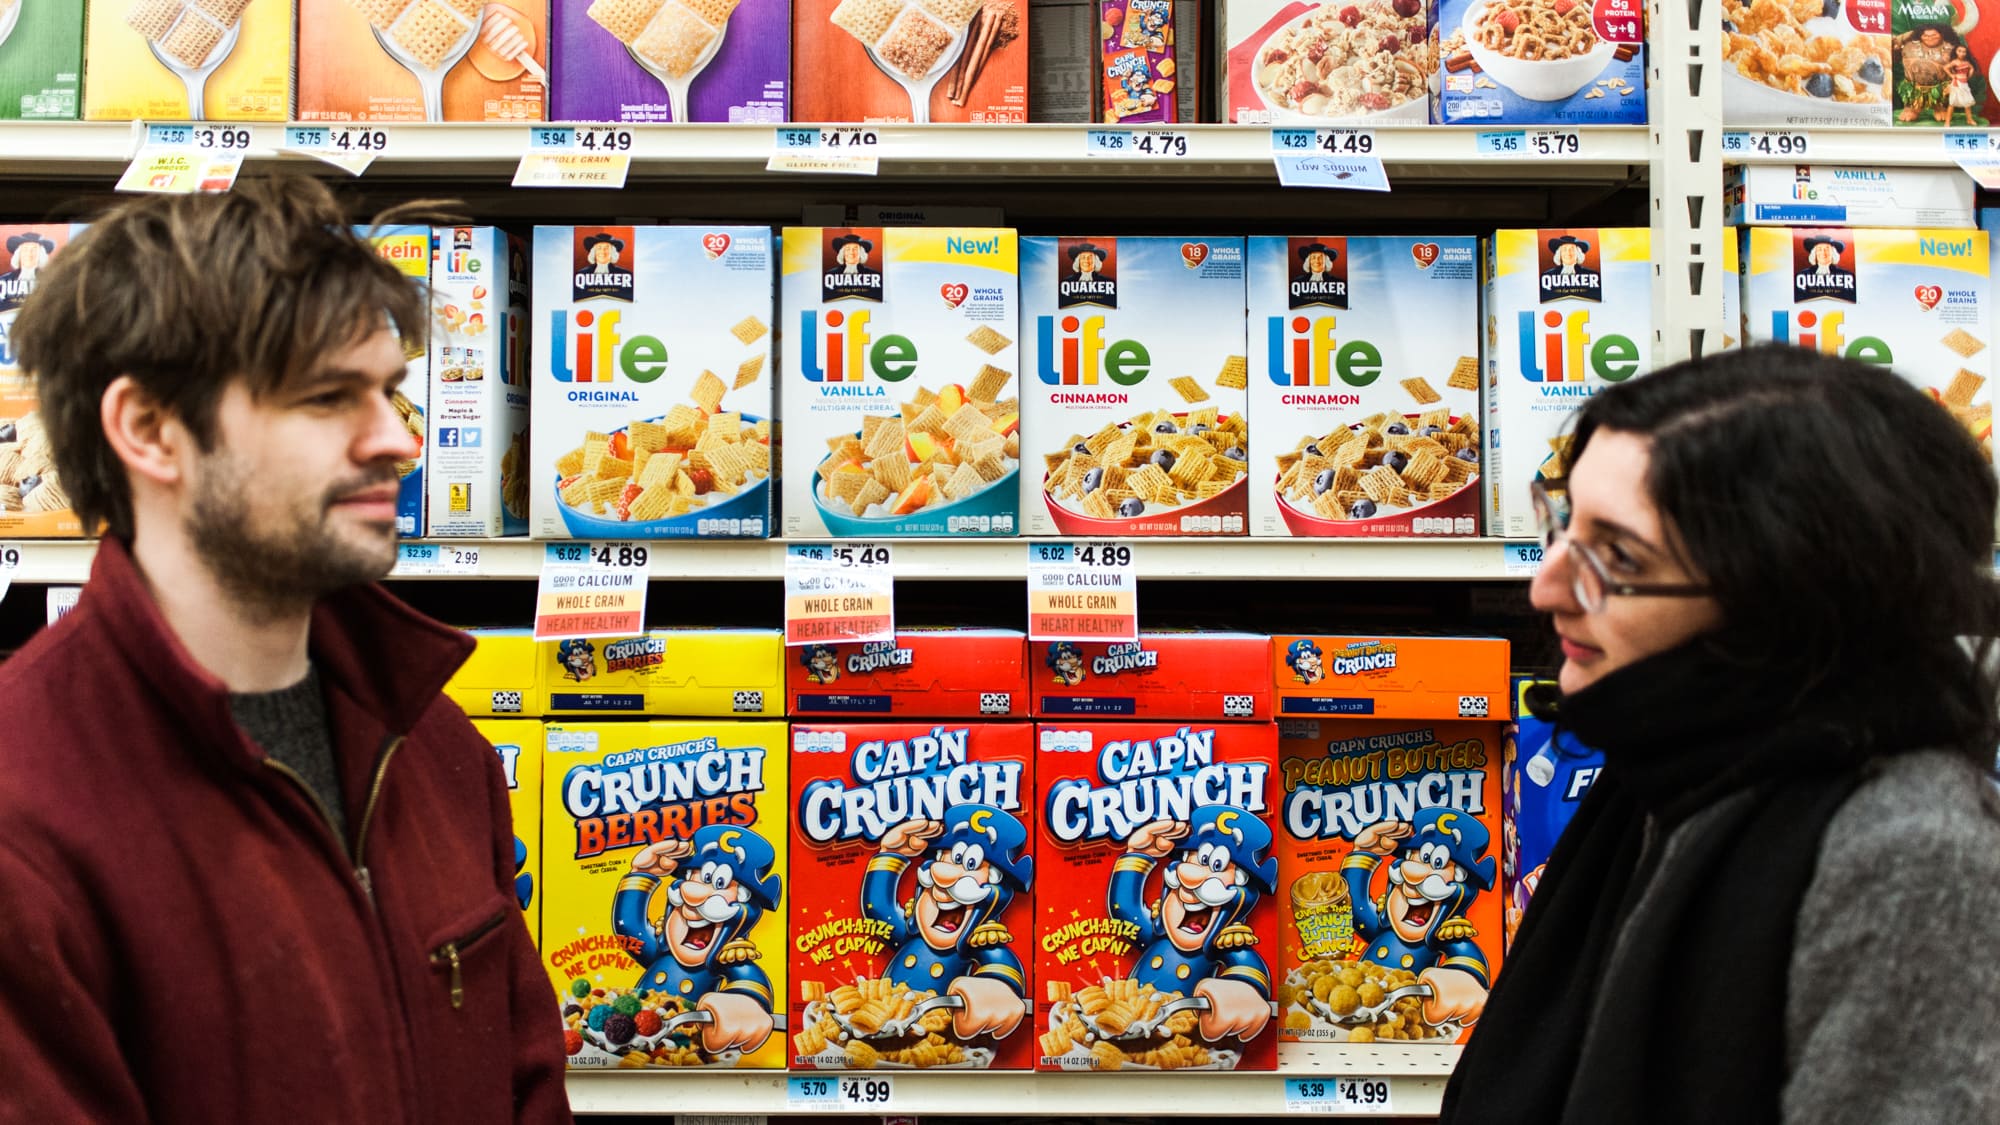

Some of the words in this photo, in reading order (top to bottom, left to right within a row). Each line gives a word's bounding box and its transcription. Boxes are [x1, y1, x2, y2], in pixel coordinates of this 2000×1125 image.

[1898, 5, 1949, 16] MOANA
[1108, 56, 1146, 78] CRUNCH
[195, 130, 249, 148] $3.99
[296, 132, 321, 144] $5.75
[331, 132, 386, 150] $4.49
[540, 133, 565, 145] $5.94
[576, 132, 631, 150] $4.49
[786, 134, 811, 146] $5.94
[1097, 136, 1123, 148] $4.26
[1133, 136, 1186, 156] $4.79
[1281, 135, 1307, 148] $4.23
[1317, 135, 1372, 153] $4.49
[1492, 138, 1517, 150] $5.45
[1532, 134, 1579, 154] $5.79
[1751, 136, 1807, 154] $4.99
[1323, 164, 1367, 173] SODIUM
[1834, 170, 1886, 181] VANILLA
[1793, 183, 1818, 200] life
[879, 212, 926, 220] ORIGINAL
[708, 238, 726, 248] 20
[947, 236, 999, 254] New!
[1189, 247, 1201, 257] 18
[1420, 247, 1433, 257] 18
[1919, 238, 1972, 256] New!
[448, 251, 481, 273] life
[575, 273, 632, 288] QUAKER
[824, 273, 881, 289] QUAKER
[1061, 281, 1114, 296] QUAKER
[1291, 281, 1346, 296] QUAKER
[1541, 274, 1599, 290] QUAKER
[1796, 273, 1854, 289] QUAKER
[946, 288, 963, 298] 20
[1920, 289, 1937, 300] 20
[551, 310, 668, 383] life
[801, 309, 918, 382] life
[1038, 315, 1150, 386] life
[1268, 316, 1382, 387] life
[1518, 309, 1639, 382] life
[568, 391, 639, 402] ORIGINAL
[821, 386, 885, 397] VANILLA
[1050, 393, 1128, 404] CINNAMON
[1282, 395, 1359, 405] CINNAMON
[407, 550, 432, 558] $2.99
[455, 551, 478, 564] 2.99
[555, 548, 581, 560] $6.02
[591, 547, 647, 567] $4.89
[833, 548, 889, 567] $5.49
[1039, 548, 1064, 560] $6.02
[1074, 546, 1130, 566] $4.89
[1518, 549, 1543, 562] $6.02
[578, 575, 632, 587] CALCIUM
[1067, 574, 1122, 586] CALCIUM
[557, 596, 590, 609] WHOLE
[594, 595, 624, 608] GRAIN
[805, 599, 839, 613] WHOLE
[843, 598, 873, 611] GRAIN
[1049, 596, 1082, 608] WHOLE
[1087, 595, 1117, 608] GRAIN
[546, 618, 580, 632] HEART
[584, 615, 630, 631] HEALTHY
[797, 622, 830, 638] HEART
[1041, 618, 1074, 632] HEART
[1078, 619, 1124, 632] HEALTHY
[605, 640, 665, 660] CRUNCH
[1334, 647, 1364, 658] PEANUT
[1366, 644, 1396, 655] BUTTER
[607, 654, 663, 673] BERRIES
[848, 649, 912, 672] CRUNCH
[1092, 651, 1158, 674] CRUNCH
[1334, 654, 1396, 674] CRUNCH
[1330, 738, 1366, 754] CAP'N
[1369, 730, 1433, 749] CRUNCH'S
[606, 748, 645, 767] CAP'N
[648, 738, 715, 760] CRUNCH'S
[852, 727, 969, 784] CAP'N
[1098, 727, 1215, 784] CAP'N
[1283, 750, 1385, 793] PEANUT
[1388, 740, 1486, 779] BUTTER
[567, 748, 766, 818] CRUNCH
[802, 760, 1022, 842] CRUNCH
[1047, 760, 1268, 841] CRUNCH
[1286, 771, 1485, 839] CRUNCH
[576, 793, 756, 858] BERRIES
[1295, 908, 1313, 920] GIVE
[1315, 905, 1329, 913] ME
[1330, 904, 1352, 913] THAT
[1296, 914, 1353, 932] PEANUT
[1300, 926, 1354, 945] BUTTER
[810, 948, 834, 965] ME
[834, 937, 885, 958] CAP'N!
[1056, 948, 1080, 966] ME
[1081, 936, 1131, 957] CAP'N!
[1297, 938, 1366, 961] CRUNCH!
[565, 964, 586, 980] ME
[588, 952, 635, 970] CAP'N!
[571, 1057, 578, 1065] 13
[580, 1057, 587, 1065] OZ
[588, 1057, 600, 1065] (370
[602, 1057, 608, 1066] g)
[1042, 1057, 1052, 1065] NET
[1053, 1057, 1062, 1065] WT
[801, 1082, 827, 1095] $5.70
[842, 1081, 889, 1102] $4.99
[1299, 1083, 1324, 1097] $6.39
[1340, 1082, 1388, 1103] $4.99
